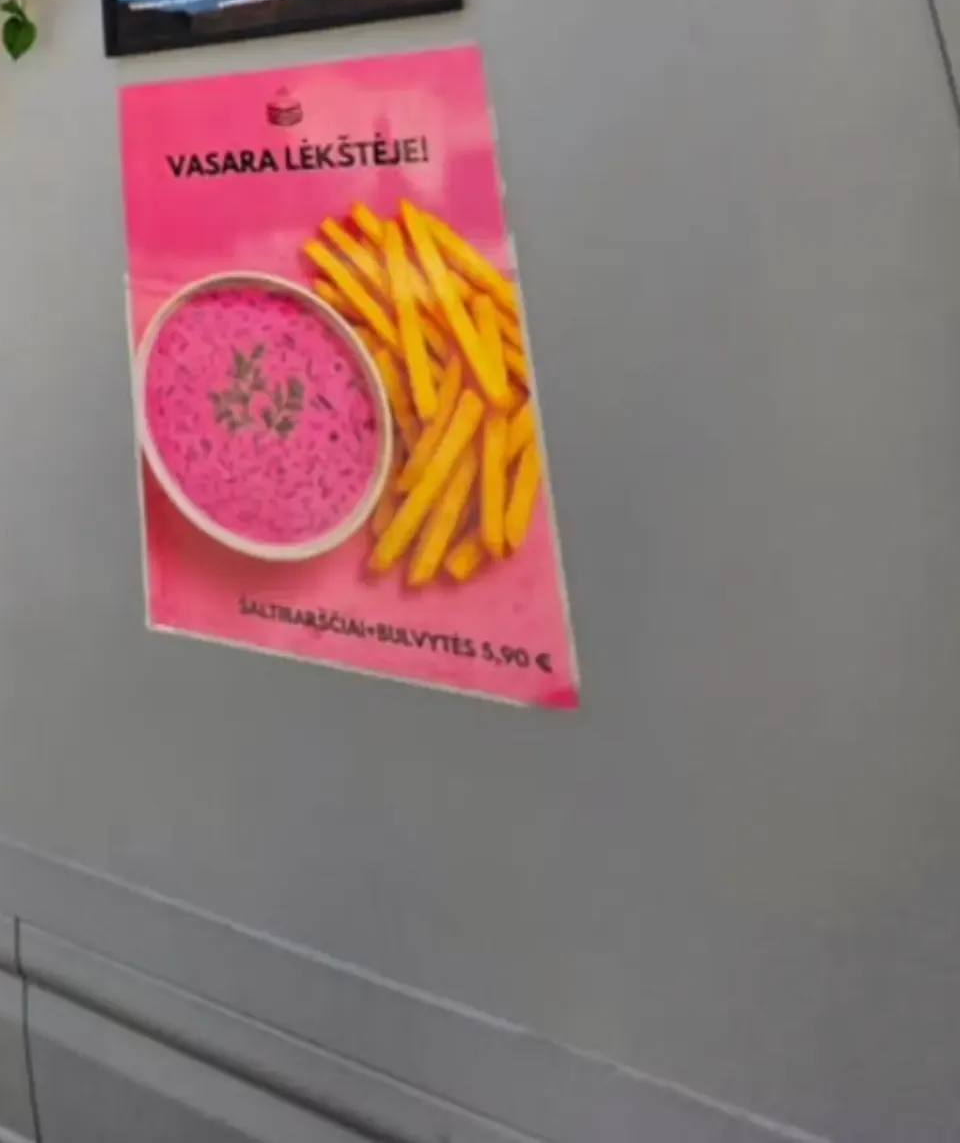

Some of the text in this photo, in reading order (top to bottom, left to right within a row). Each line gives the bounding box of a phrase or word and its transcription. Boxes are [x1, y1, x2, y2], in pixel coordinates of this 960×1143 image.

[166, 132, 429, 178] VASARA LĖKŠTĖJE!
[480, 640, 530, 668] 5,90
[534, 651, 553, 674] €
